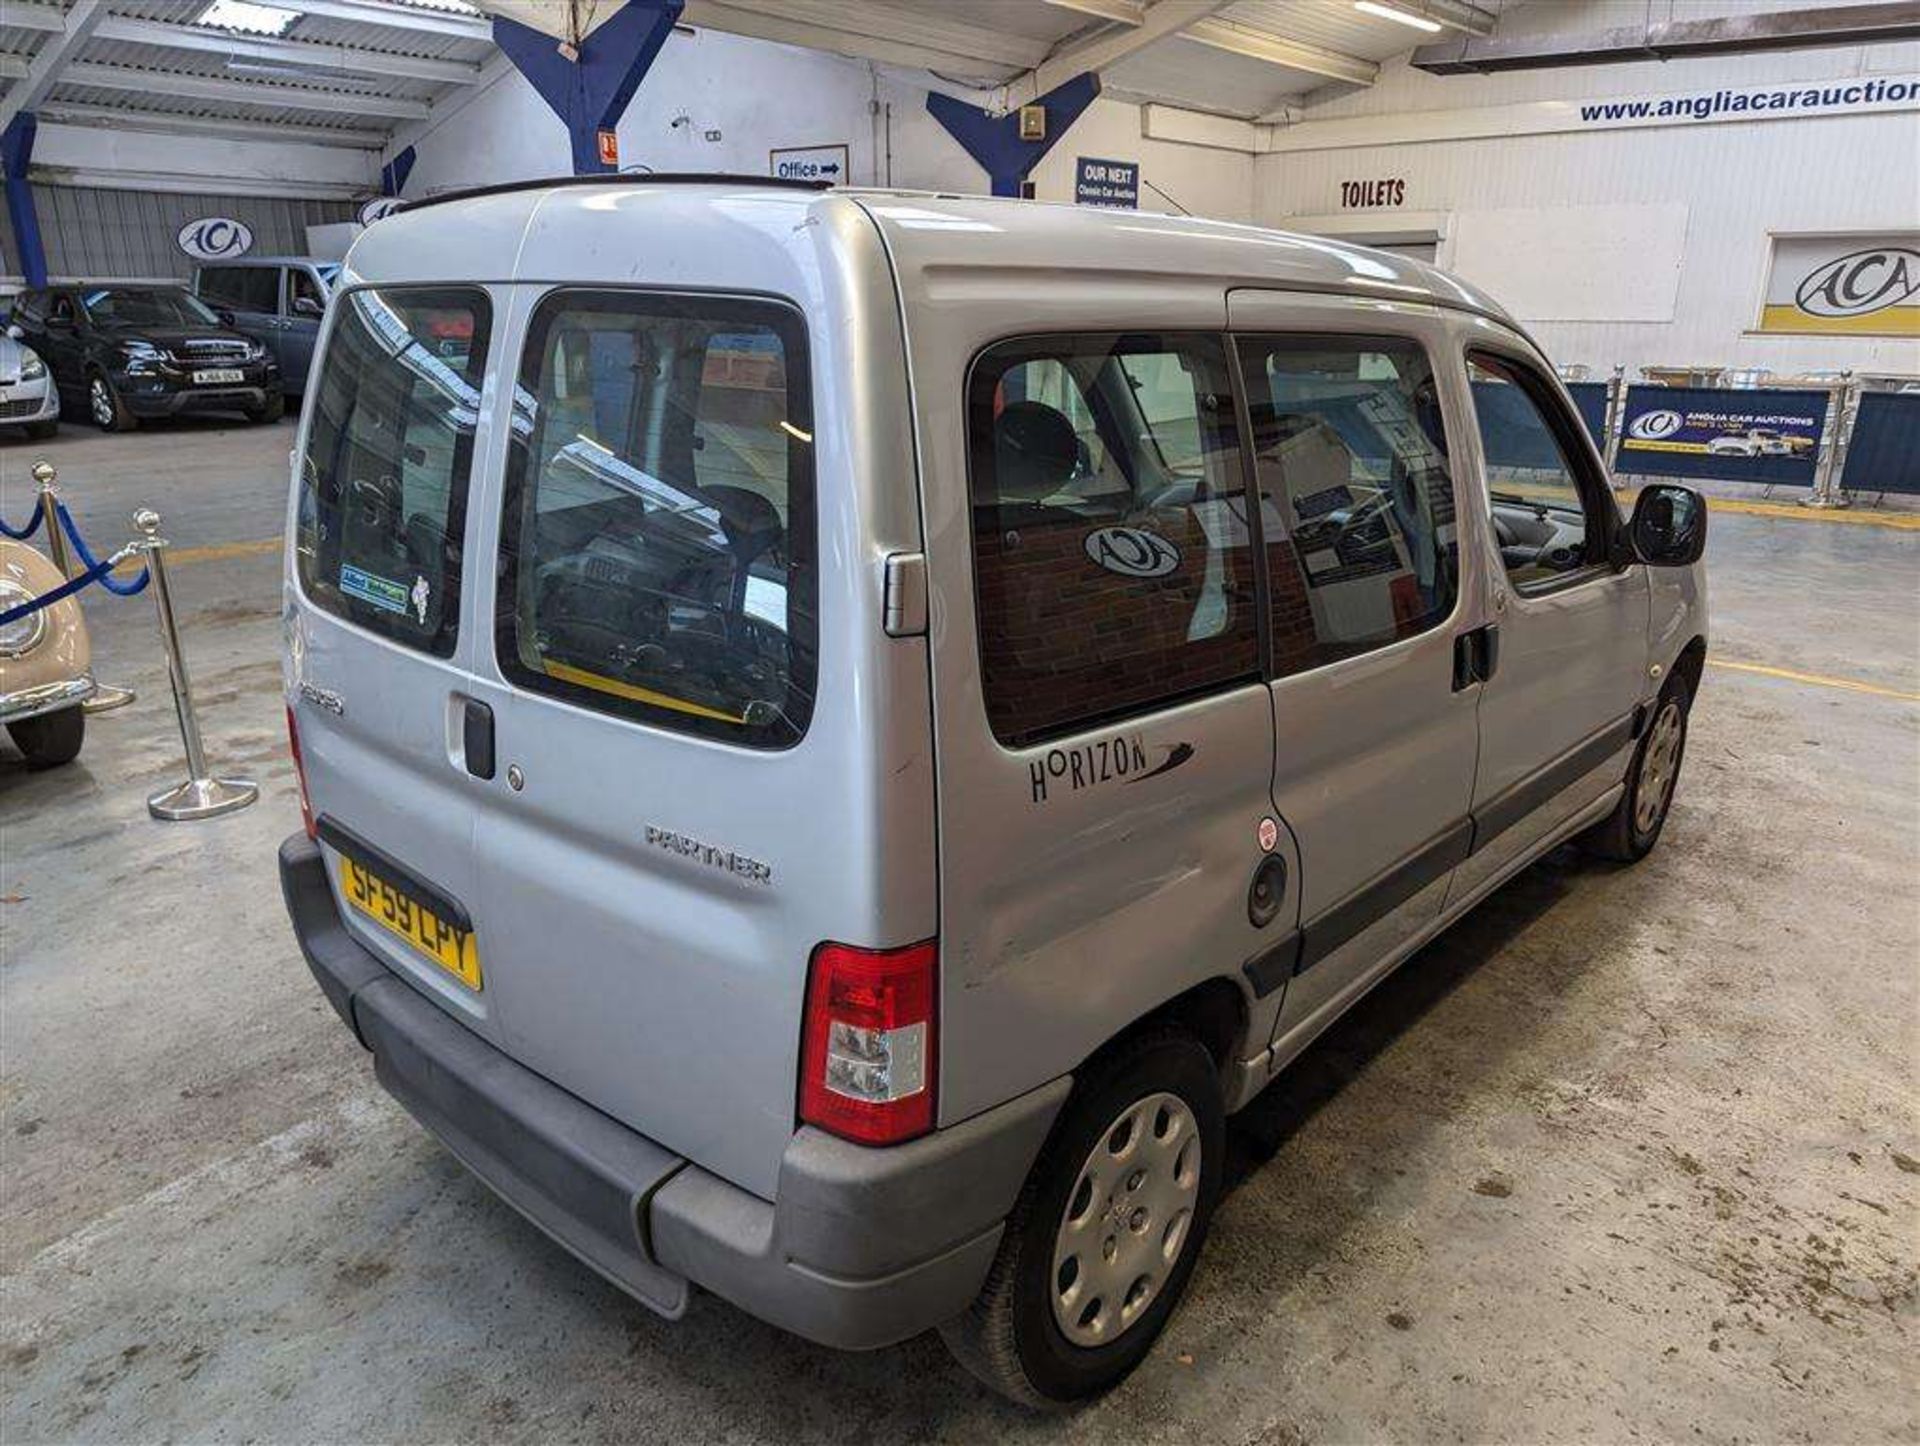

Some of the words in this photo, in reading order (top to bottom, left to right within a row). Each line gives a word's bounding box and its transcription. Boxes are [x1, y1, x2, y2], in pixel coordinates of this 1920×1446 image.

[779, 162, 818, 178] Office
[1085, 165, 1107, 182] OUR
[1108, 168, 1132, 184] NEXT
[1341, 179, 1405, 208] TOILETS
[183, 220, 247, 252] ACA
[1800, 254, 1911, 309] ACA
[1631, 412, 1681, 436] ACA
[1687, 411, 1728, 422] ANGLIA
[1729, 414, 1754, 424] CAR
[1754, 415, 1815, 427] AUCTIONS
[1029, 727, 1147, 803] HORIZON
[644, 825, 771, 884] PARTNER
[351, 862, 412, 933] SF59
[417, 904, 466, 971] LPY
